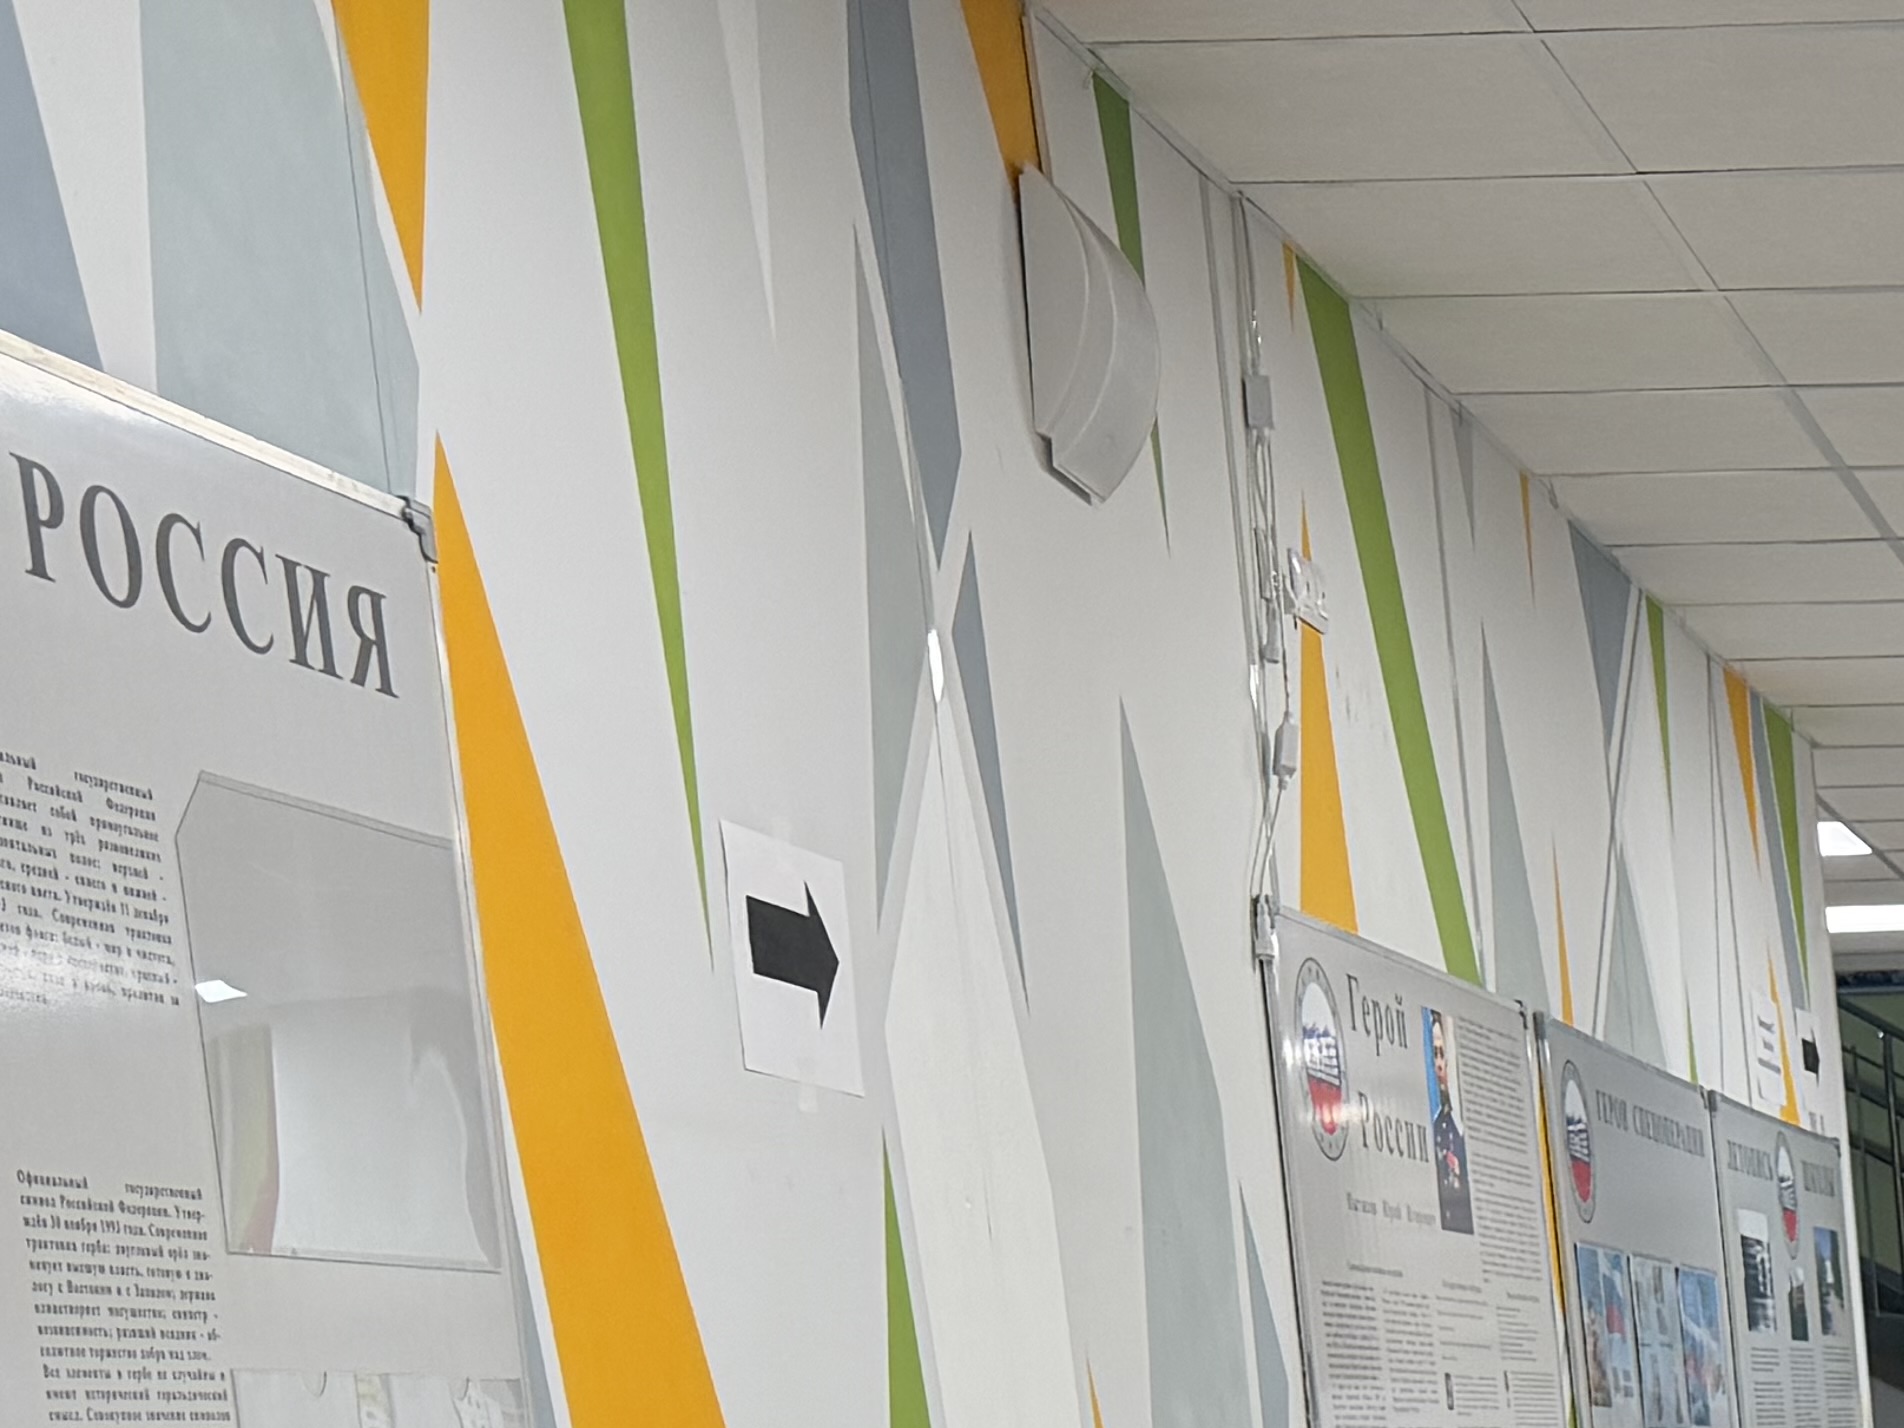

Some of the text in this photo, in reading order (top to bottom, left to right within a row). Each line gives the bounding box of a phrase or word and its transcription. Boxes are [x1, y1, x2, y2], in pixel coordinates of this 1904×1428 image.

[8, 452, 399, 699] РОССИЯ
[1346, 974, 1408, 1056] Герой
[1358, 1091, 1429, 1163] России
